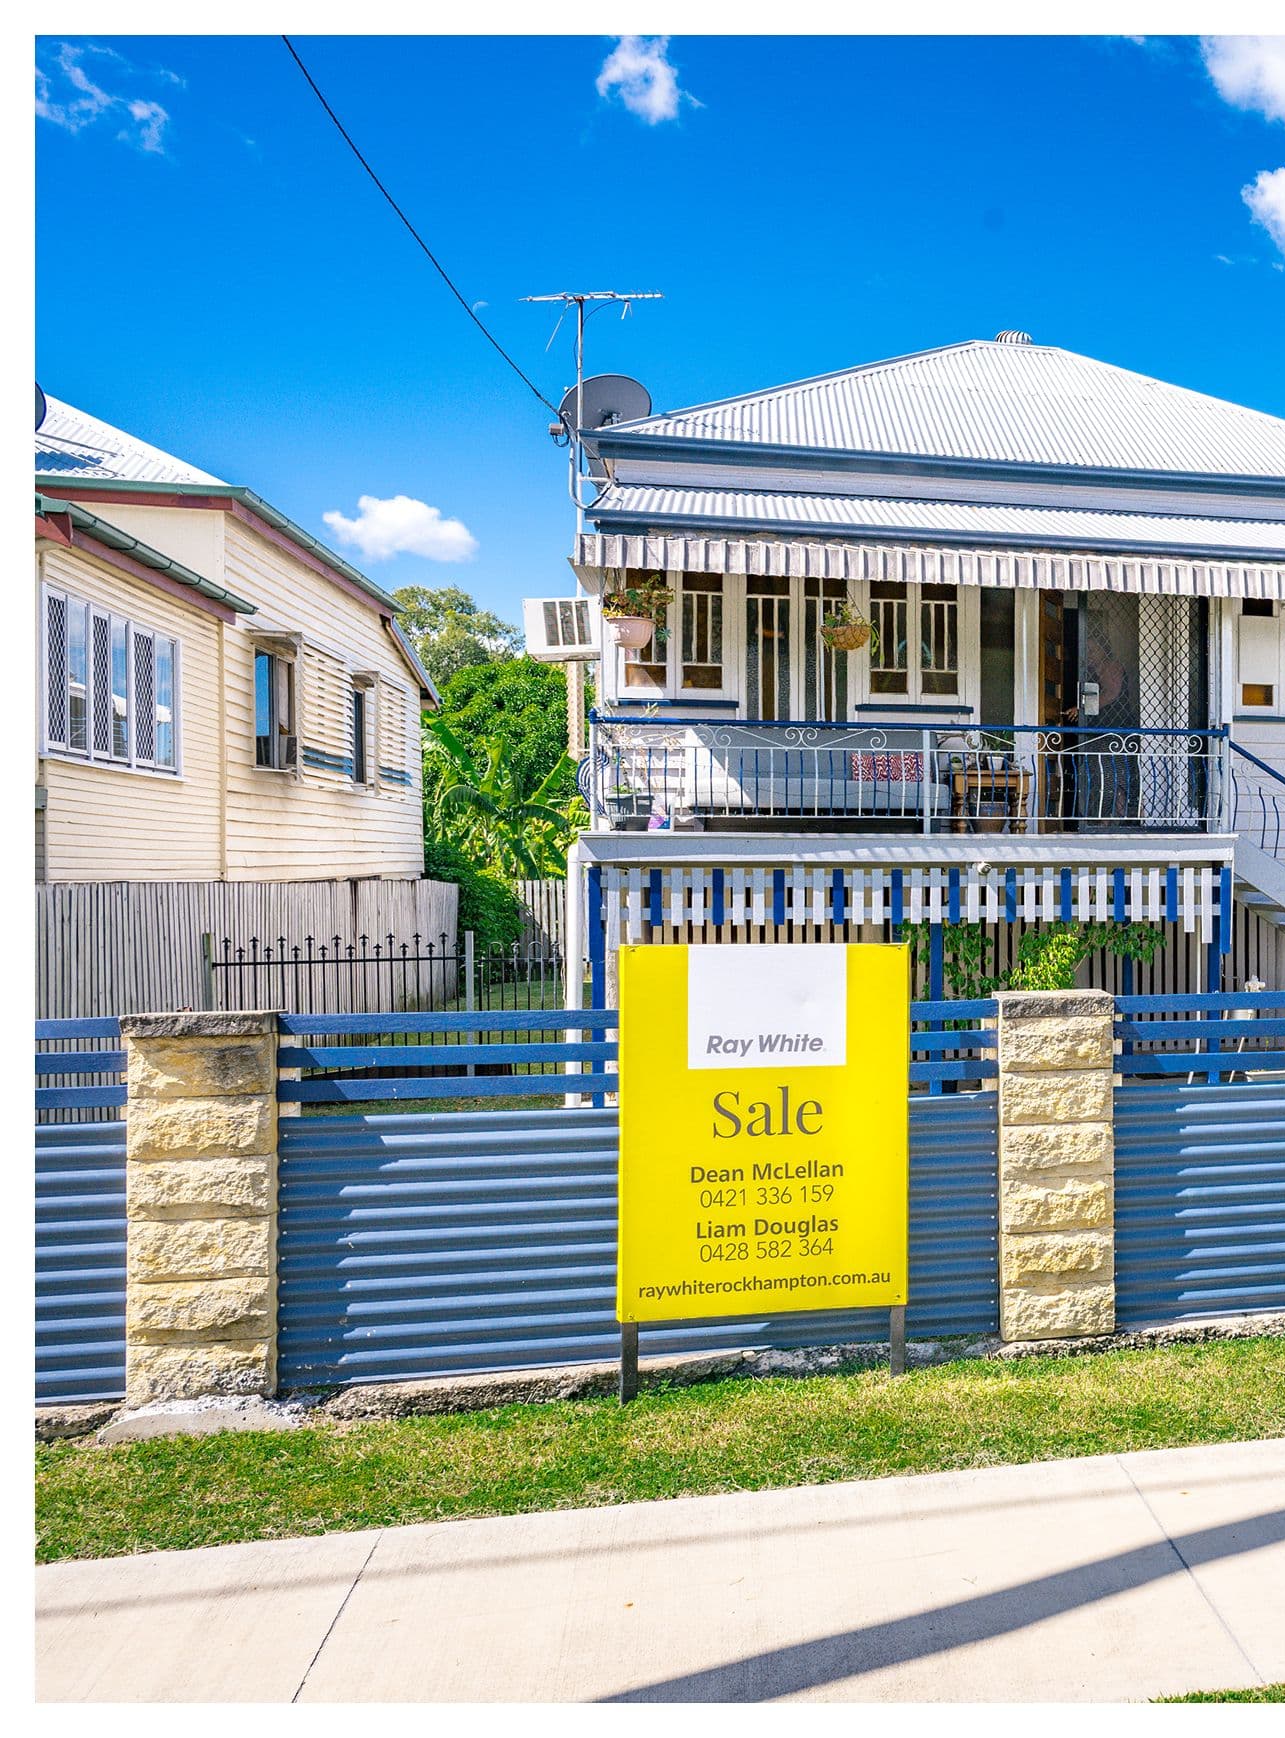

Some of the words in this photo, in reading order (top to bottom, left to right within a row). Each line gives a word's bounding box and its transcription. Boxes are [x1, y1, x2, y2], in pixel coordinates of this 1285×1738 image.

[706, 1035, 754, 1058] Ray
[758, 1033, 824, 1053] White
[712, 1085, 823, 1139] Sale
[690, 1166, 744, 1184] Dean
[752, 1160, 844, 1181] McLellan
[699, 1188, 746, 1208] 0421
[756, 1186, 793, 1206] 336
[800, 1183, 834, 1203] 159
[696, 1220, 746, 1240] Liam
[754, 1214, 839, 1238] Douglas
[699, 1242, 749, 1262] 0428
[756, 1240, 792, 1260] 582
[799, 1237, 834, 1257] 364
[638, 1271, 891, 1301] raywhiterockhampton.com.au
